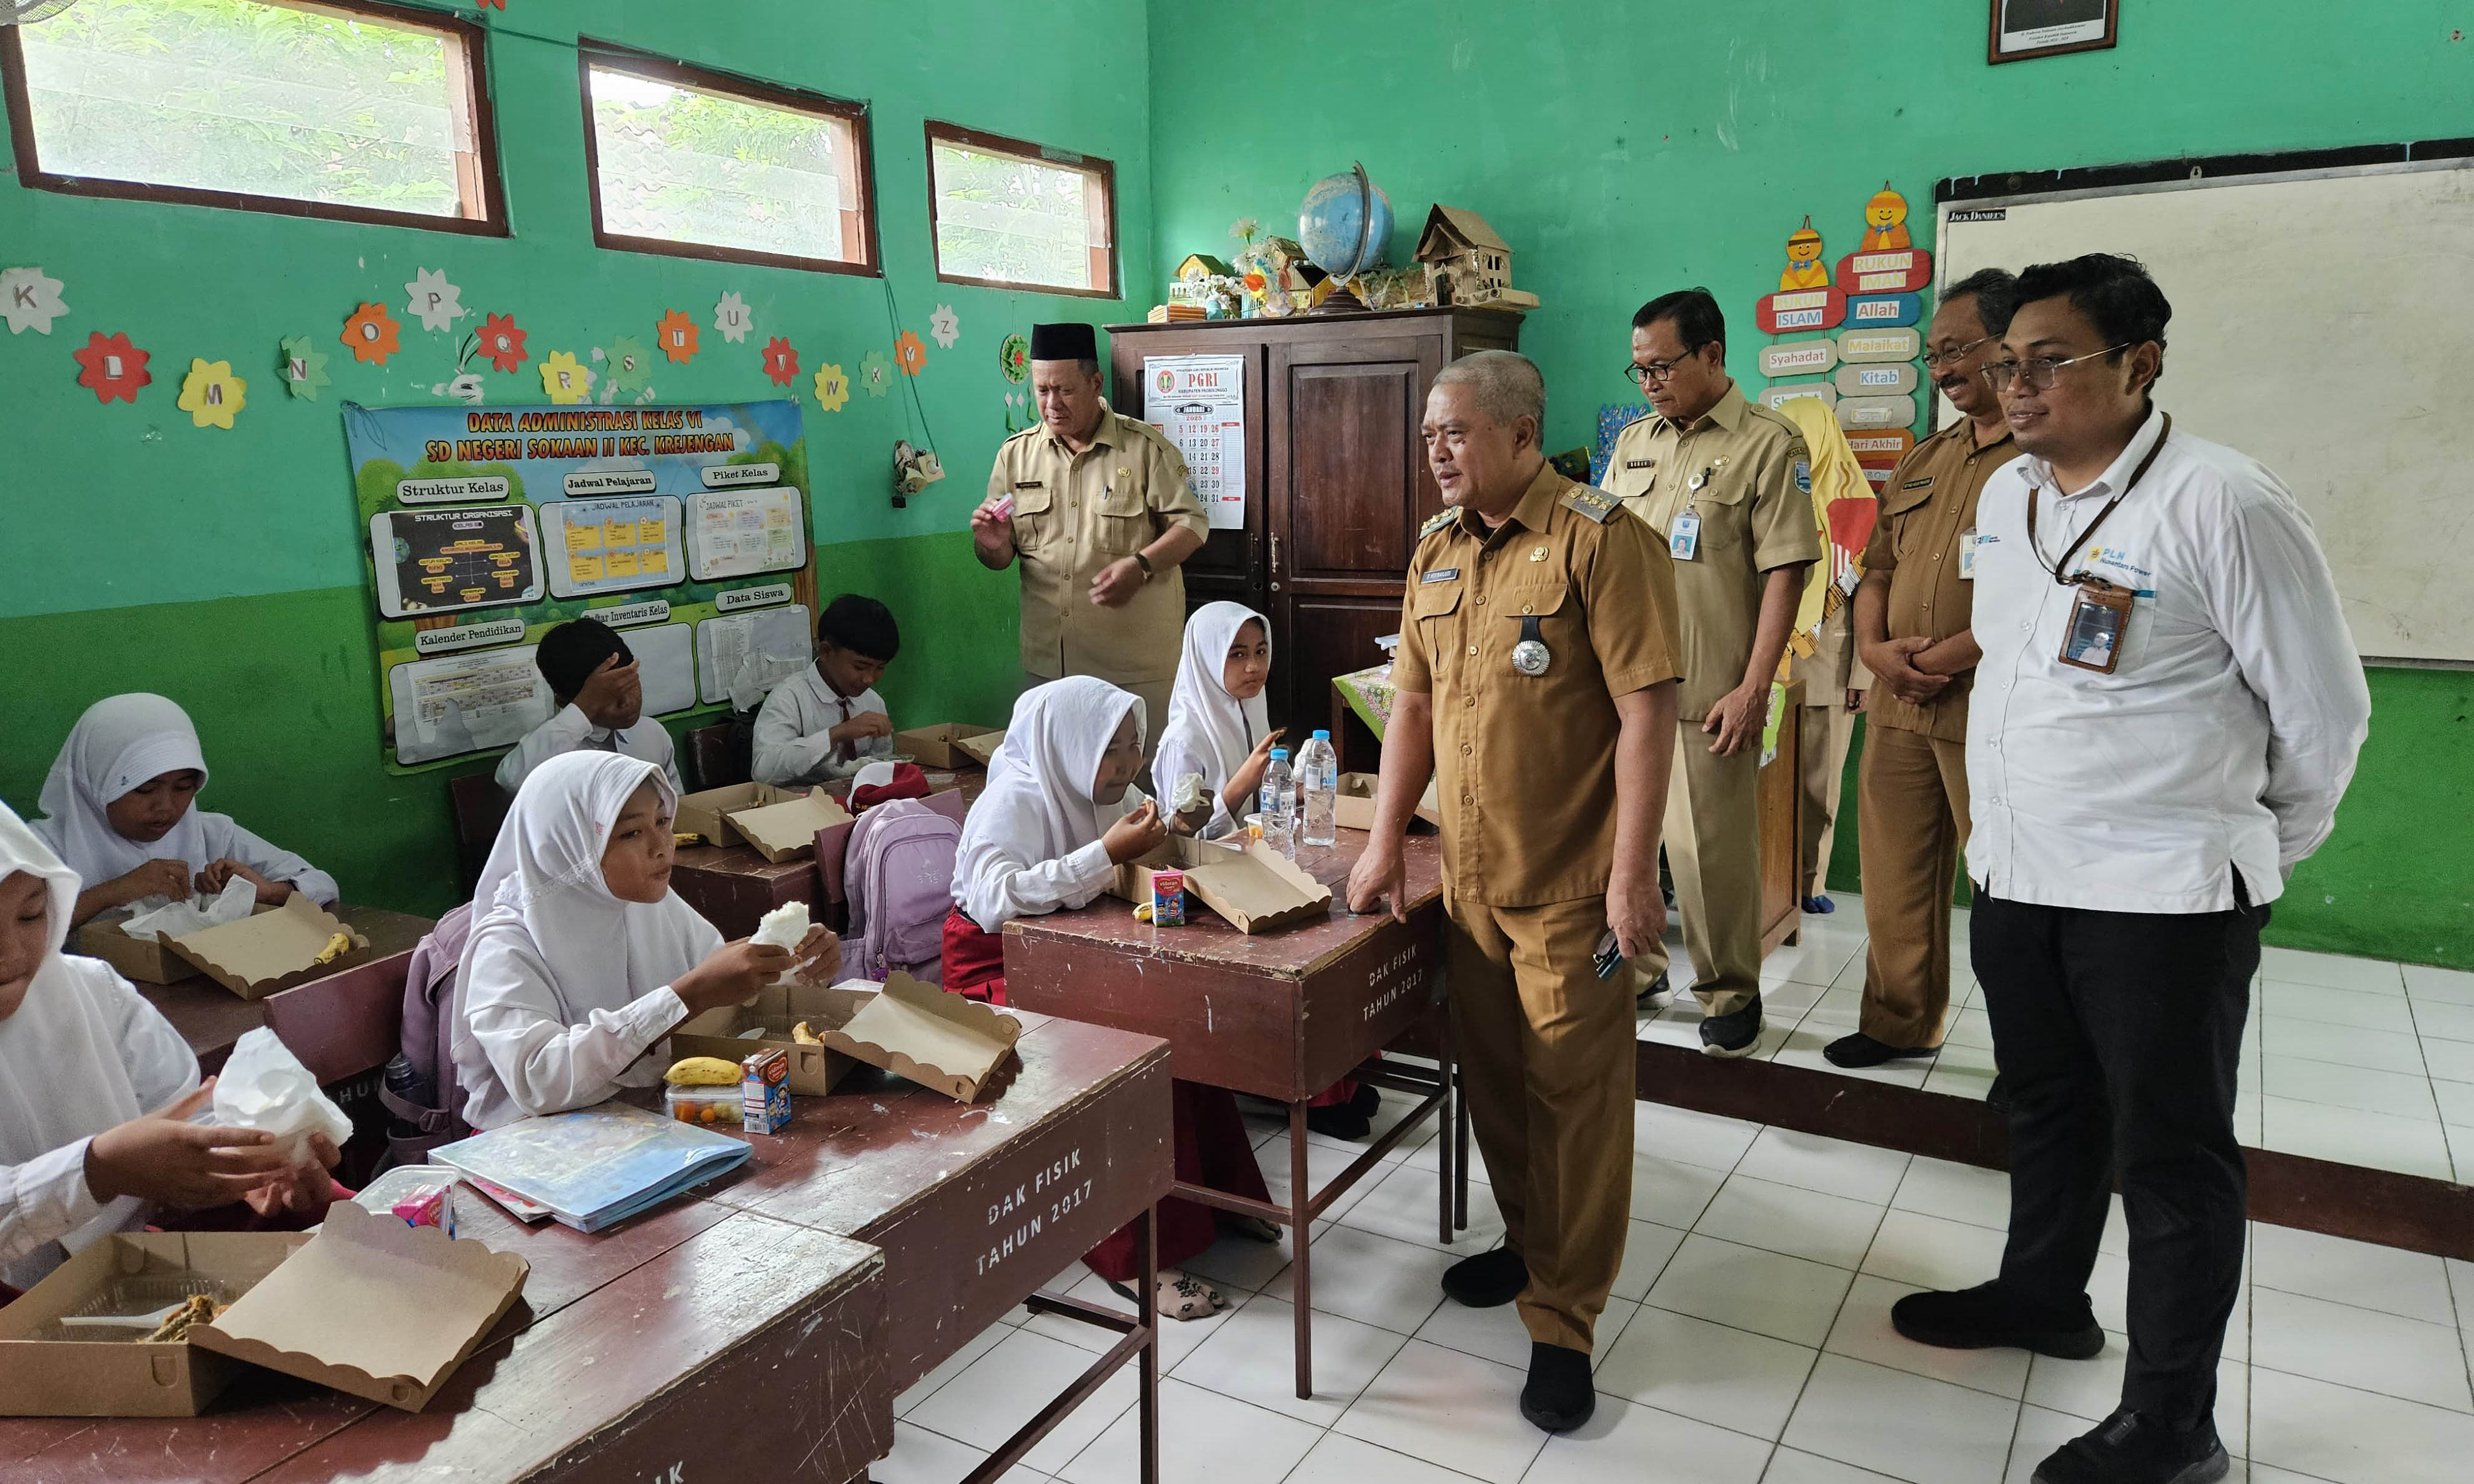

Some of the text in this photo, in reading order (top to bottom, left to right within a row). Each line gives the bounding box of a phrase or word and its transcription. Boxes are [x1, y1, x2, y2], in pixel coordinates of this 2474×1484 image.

[1854, 254, 1912, 271] RUKUN
[1862, 273, 1905, 288] IMAN
[13, 285, 37, 310] K
[428, 292, 442, 311] P
[1774, 294, 1825, 310] RUKUN
[1858, 302, 1898, 317] Allah
[728, 310, 740, 327] U
[1777, 311, 1821, 326] ISLAM
[361, 321, 380, 342] O
[940, 320, 950, 335] Z
[495, 333, 512, 354] Q
[673, 328, 685, 347] T
[1849, 339, 1909, 352] Malaikat
[906, 347, 915, 362] Y
[1771, 350, 1825, 366] Syahadat
[104, 355, 122, 380] L
[289, 358, 308, 380] N
[623, 354, 634, 373] S
[777, 354, 787, 372] V
[557, 371, 571, 390] R
[1188, 372, 1218, 388] PGRI
[1860, 370, 1898, 384] Kitab
[206, 383, 223, 407] M
[827, 379, 839, 397] W
[1183, 406, 1206, 414] JANUARI
[467, 410, 704, 433] DATA ADMINISTRASI KELAS VI
[1179, 425, 1220, 433] 5 12 19 26
[425, 440, 452, 463] SD
[457, 438, 522, 462] NEGERI
[527, 437, 598, 459] SOKAAN
[618, 436, 651, 457] KEC.
[653, 432, 735, 455] KREJENGAN
[1179, 438, 1220, 447] 6 13 20 27
[1871, 439, 1901, 449] Akhir
[1189, 452, 1220, 461] 14 21 28
[712, 468, 768, 480] Piket Kelas
[1189, 467, 1220, 475] 15 22 29
[402, 482, 504, 497] Struktur Kelas
[567, 475, 652, 489] Jadwal Pelajaran
[1200, 480, 1220, 488] 23 30
[592, 499, 655, 510] JADWAL PELAJARAN
[706, 500, 727, 511] JADWAL
[727, 499, 744, 509] PIKET
[1200, 494, 1220, 503] 24 31
[414, 510, 514, 522] STRUKTUR ORGANISASI
[2103, 548, 2125, 560] PLN
[2129, 565, 2151, 577] Power
[726, 588, 784, 605] Data Siswa
[610, 606, 647, 621] Inventaris
[649, 604, 668, 616] Kelas
[420, 625, 522, 646] Kalender Pendidikan
[1368, 943, 1418, 987] DAK FISIK
[1363, 968, 1423, 1022] TAHUN 2017
[988, 1148, 1081, 1225] DAK FISIK
[976, 1179, 1093, 1276] TAHUN 2017
